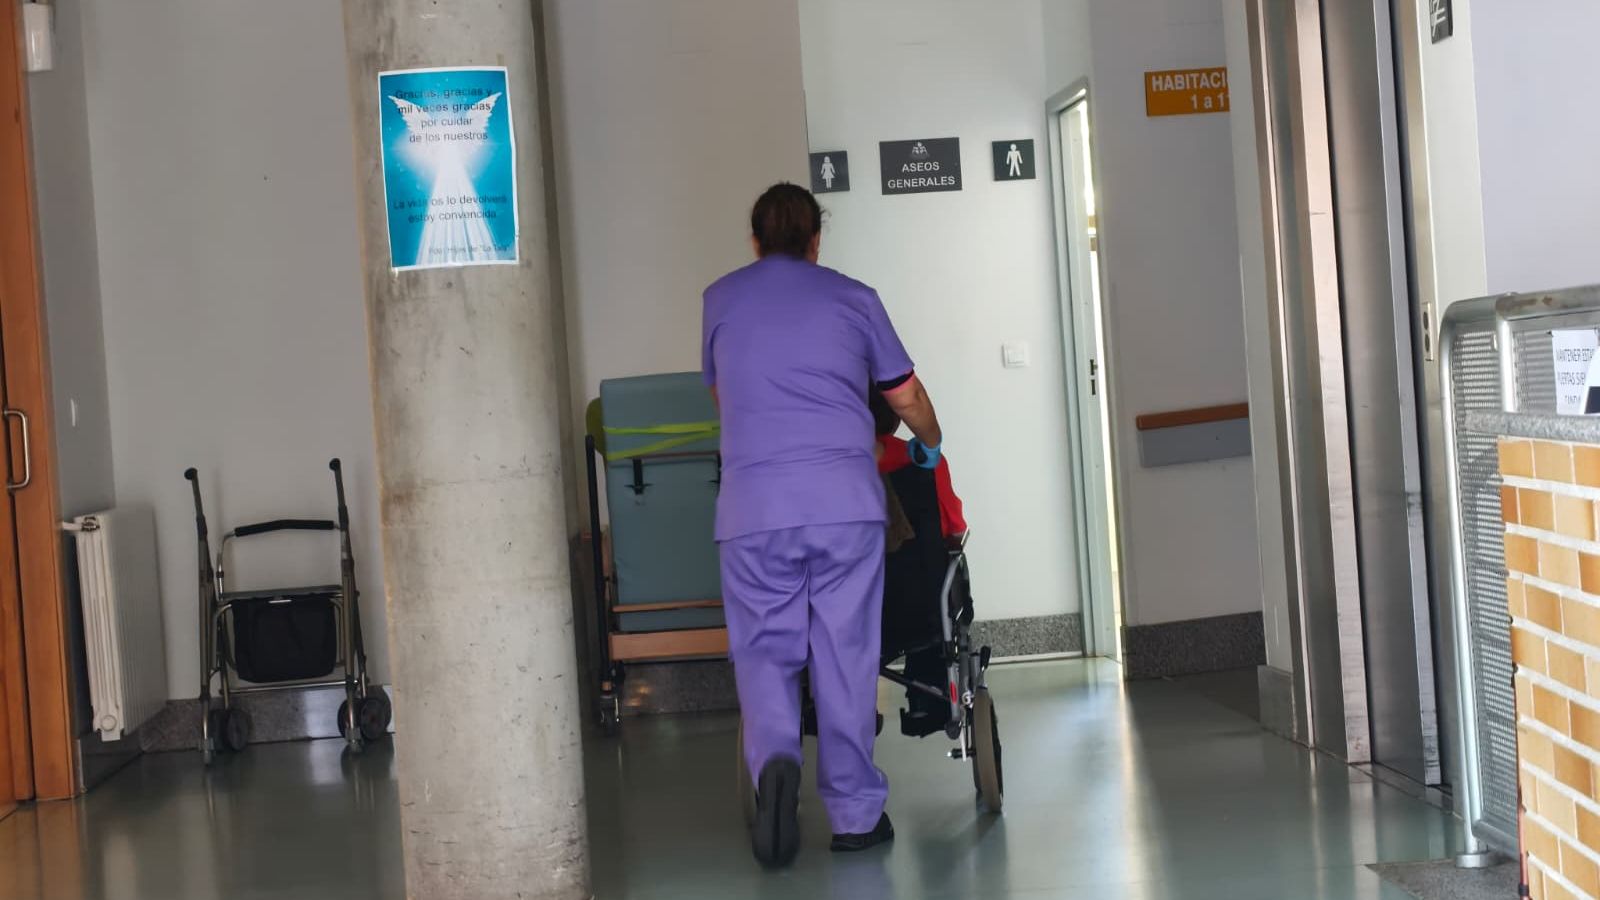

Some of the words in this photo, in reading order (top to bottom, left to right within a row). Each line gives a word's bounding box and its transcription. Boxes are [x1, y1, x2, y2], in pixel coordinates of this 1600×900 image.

[1152, 71, 1226, 92] HABITACI
[443, 87, 482, 99] gracias
[483, 87, 492, 97] y
[398, 104, 413, 114] mil
[416, 103, 449, 113] veces
[452, 101, 492, 113] gracias
[1190, 94, 1198, 110] 1
[1203, 95, 1213, 109] a
[1217, 92, 1230, 108] 1
[421, 119, 437, 130] por
[441, 116, 472, 127] cuidar
[409, 133, 422, 143] de
[425, 132, 441, 142] los
[443, 131, 489, 141] nuestros
[902, 161, 940, 173] ASEOS
[887, 176, 956, 189] GENERALES
[393, 200, 405, 209] La
[431, 197, 444, 206] os
[446, 195, 457, 205] lo
[408, 212, 435, 223] estoy
[438, 209, 497, 220] convencida
